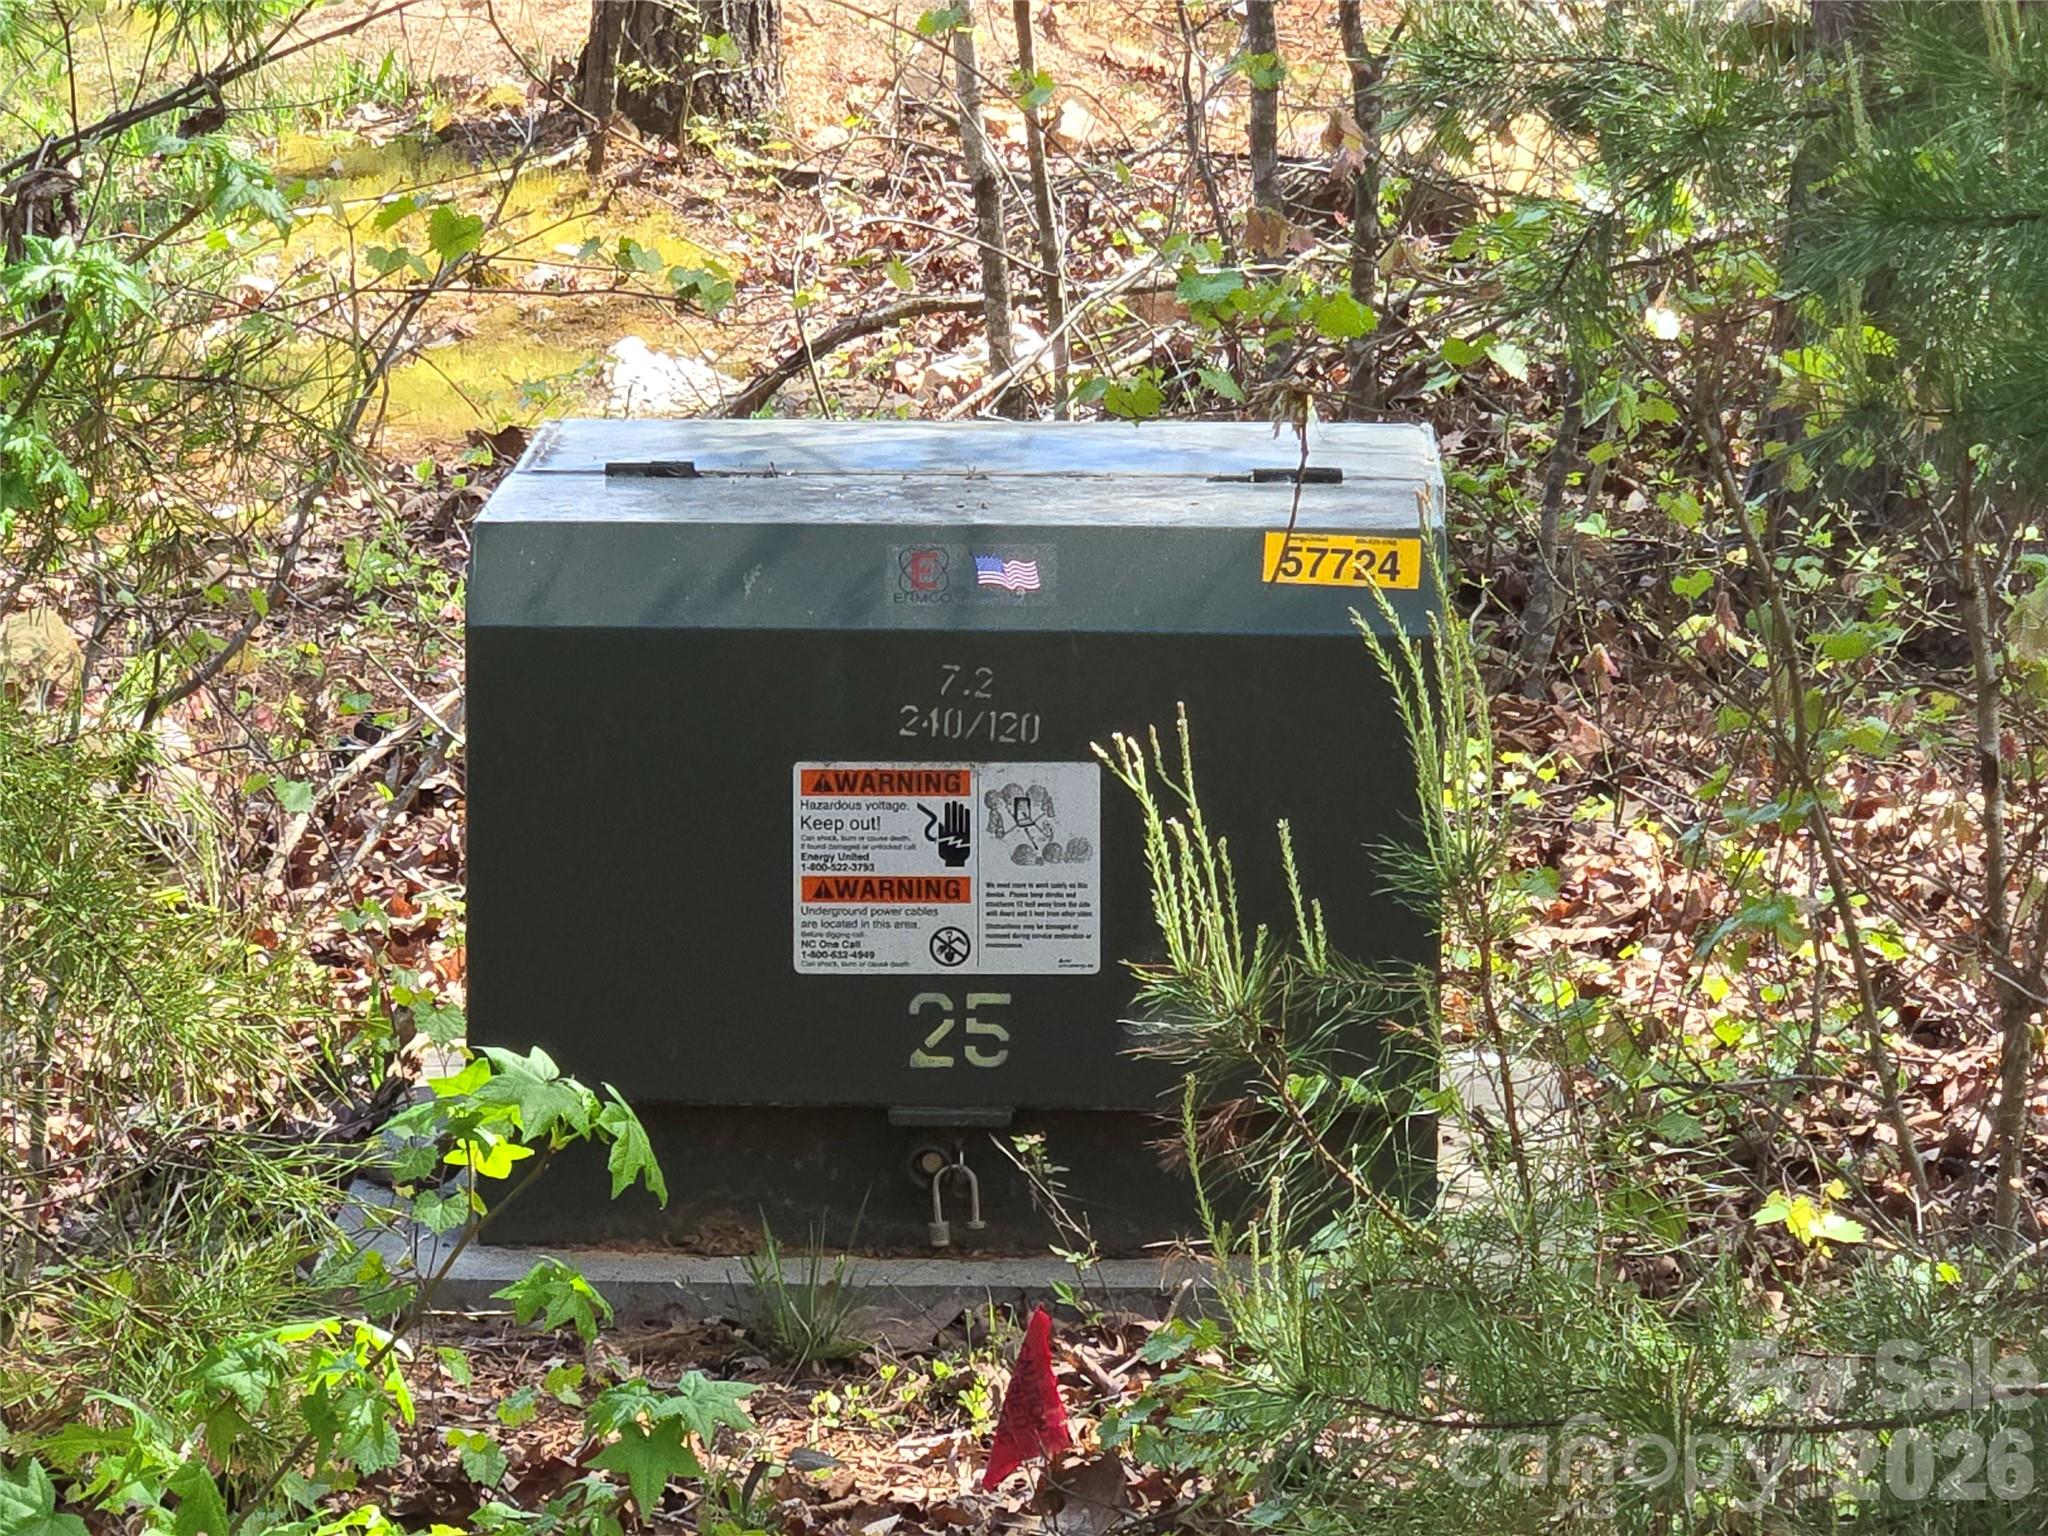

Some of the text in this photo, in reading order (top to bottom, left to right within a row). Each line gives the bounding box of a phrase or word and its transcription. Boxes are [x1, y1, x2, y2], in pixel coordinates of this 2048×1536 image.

[1279, 546, 1400, 582] 57724
[893, 591, 953, 604] ERMCO
[940, 664, 993, 698] 7.2
[899, 704, 1040, 743] 240/120
[835, 772, 962, 793] WARNING
[800, 800, 911, 813] Hazardous voltage.
[800, 816, 881, 834] Keep out!
[801, 852, 870, 863] Energy United
[835, 879, 962, 899] WARNING
[800, 906, 939, 918] Underground power cables
[800, 919, 817, 929] are
[820, 919, 858, 929] located
[861, 919, 870, 929] in
[873, 919, 891, 929] this
[801, 940, 861, 948] NC One Call
[801, 950, 875, 959] 1-800-632-4949
[909, 992, 1012, 1068] 25
